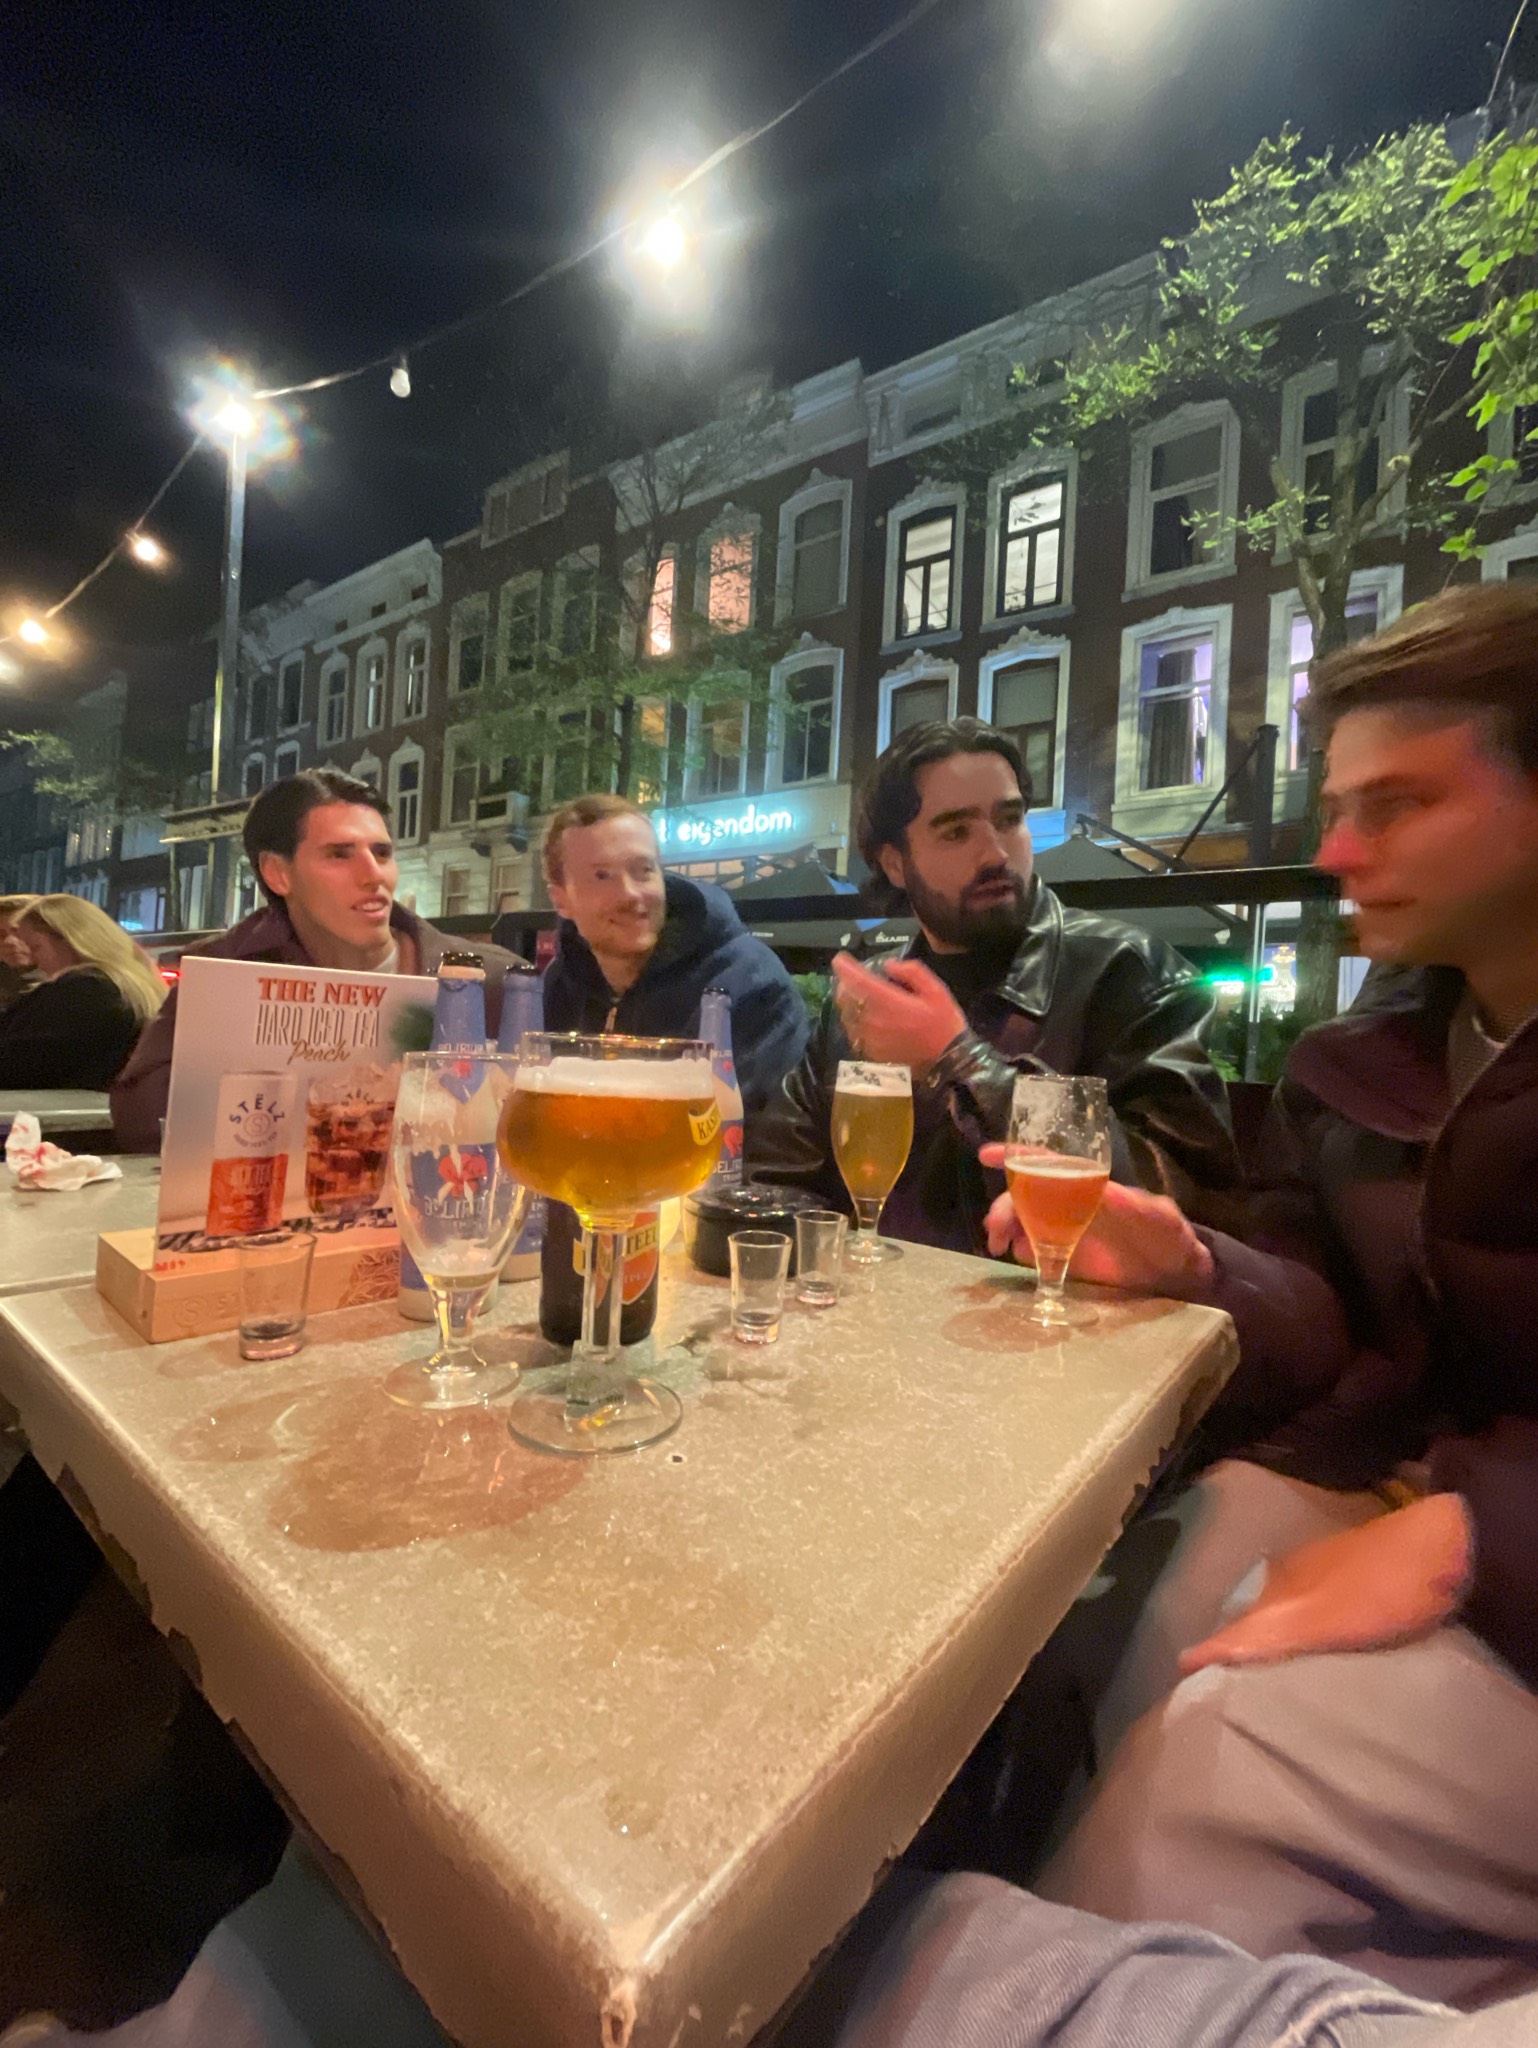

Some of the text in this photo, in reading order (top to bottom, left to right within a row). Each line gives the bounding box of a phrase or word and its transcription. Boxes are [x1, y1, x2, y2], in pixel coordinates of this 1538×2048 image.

[676, 803, 794, 846] eigendom
[257, 977, 387, 1008] THE NEW
[256, 1003, 380, 1048] HARD ICED TEA
[286, 1038, 351, 1065] Peach
[229, 1093, 285, 1125] STËLZ
